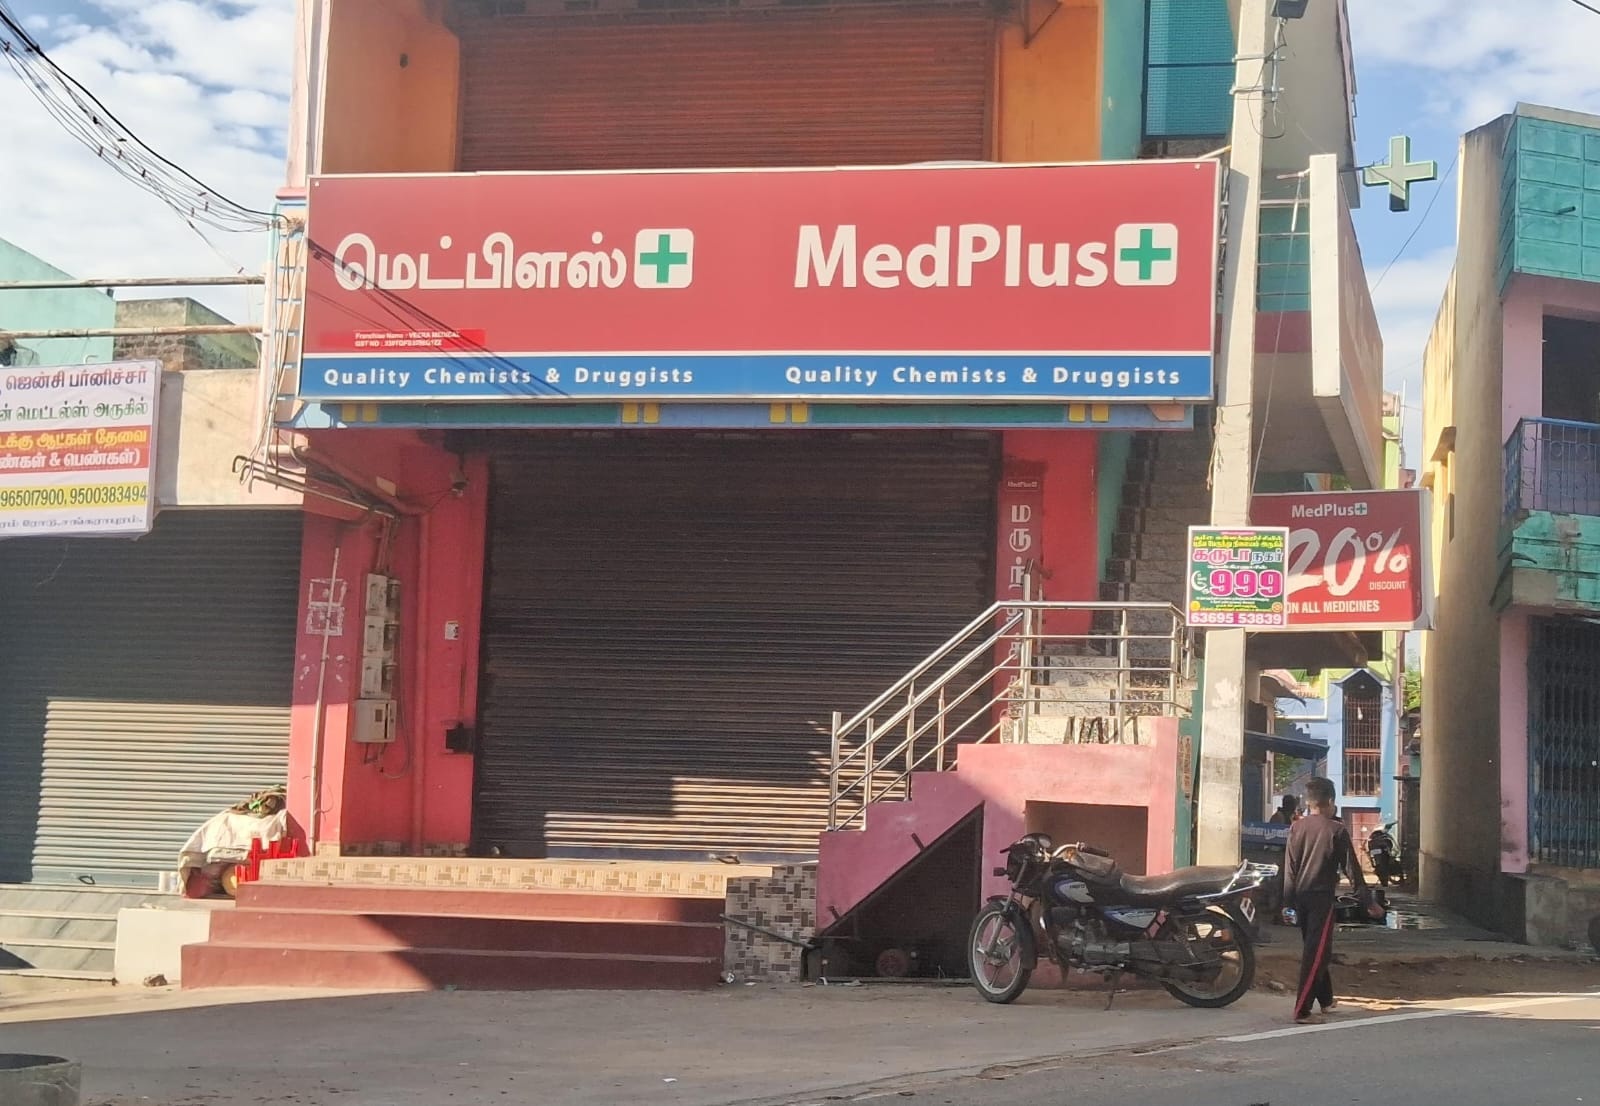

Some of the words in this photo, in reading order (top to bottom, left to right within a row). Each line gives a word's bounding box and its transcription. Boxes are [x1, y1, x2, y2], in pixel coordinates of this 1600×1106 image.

[333, 231, 628, 291] மெட்பிளஸ்
[794, 222, 1109, 289] MedPlus
[324, 368, 410, 387] Quality
[424, 367, 531, 384] Chemists
[545, 368, 560, 383] &
[575, 367, 693, 387] Druggists
[785, 366, 877, 386] Quality
[892, 367, 1007, 383] Chemists
[1022, 367, 1037, 383] &
[1053, 367, 1180, 387] Druggists
[93, 396, 148, 420] அருகில்
[95, 428, 147, 447] தேவை
[49, 453, 60, 467] &
[70, 485, 147, 504] 9500383494
[1291, 503, 1355, 518] MedPlus
[1192, 548, 1252, 566] கருடா
[1287, 527, 1409, 597] 20%
[1209, 568, 1284, 598] 999
[1369, 581, 1407, 591] DISCOUNT
[1302, 601, 1320, 614] ALL
[1323, 599, 1380, 613] MEDICINES
[1190, 612, 1234, 624] 63695
[1237, 613, 1282, 625] 53839
